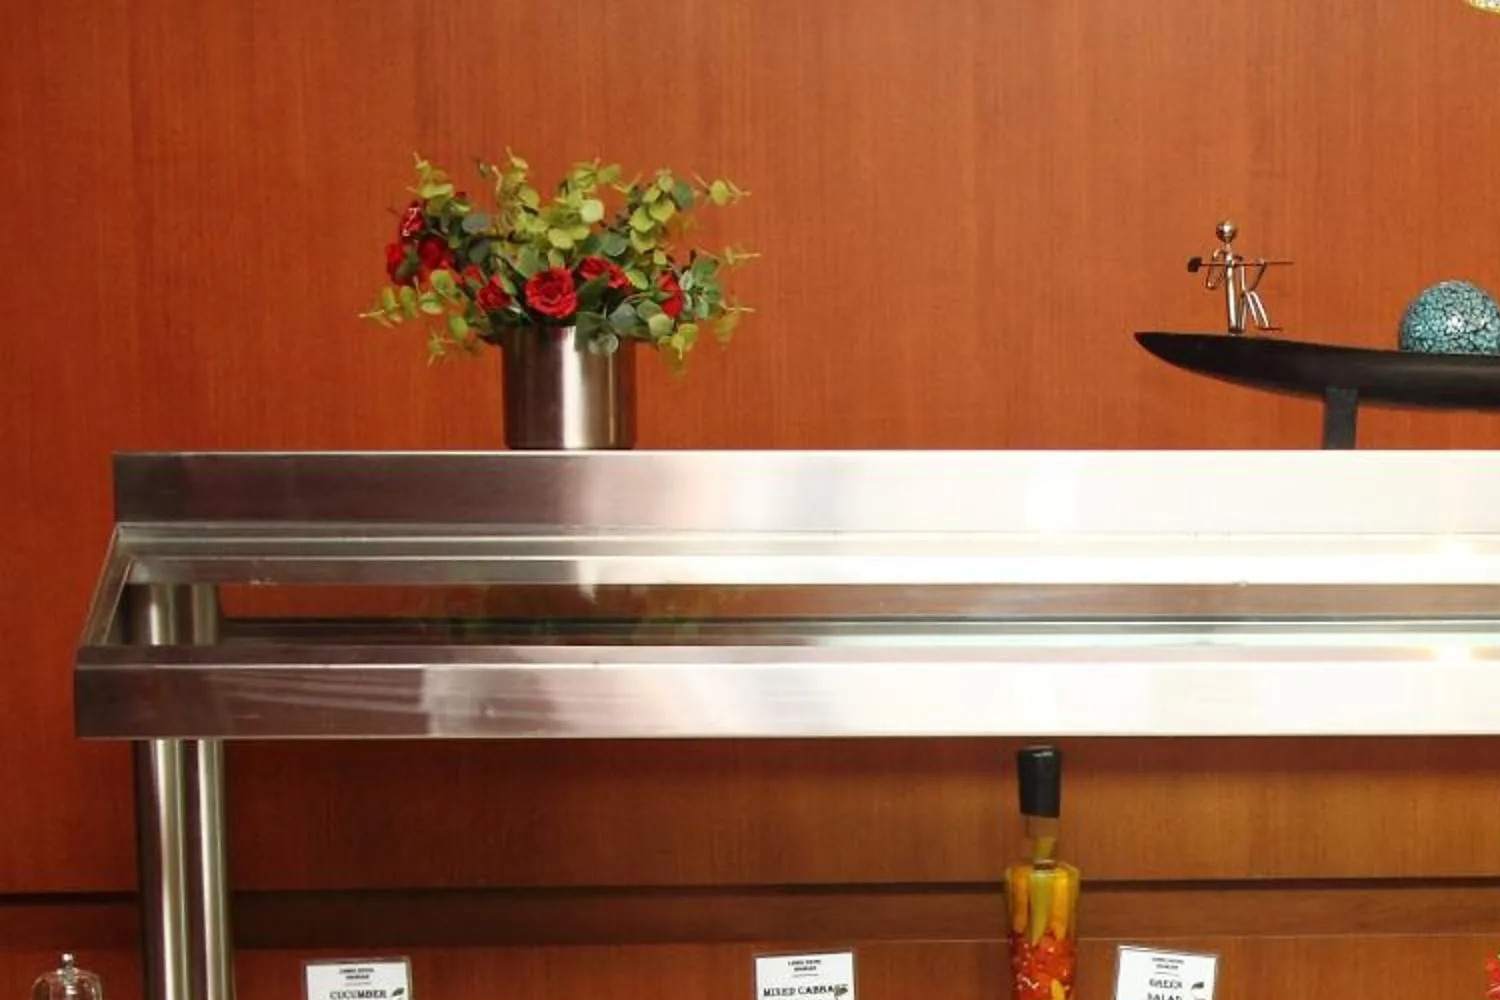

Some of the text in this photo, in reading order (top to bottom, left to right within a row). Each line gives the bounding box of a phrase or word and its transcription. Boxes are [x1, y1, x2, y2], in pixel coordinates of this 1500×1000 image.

[329, 989, 387, 1000] CUCUMBER
[763, 984, 849, 997] MIXED CABBA
